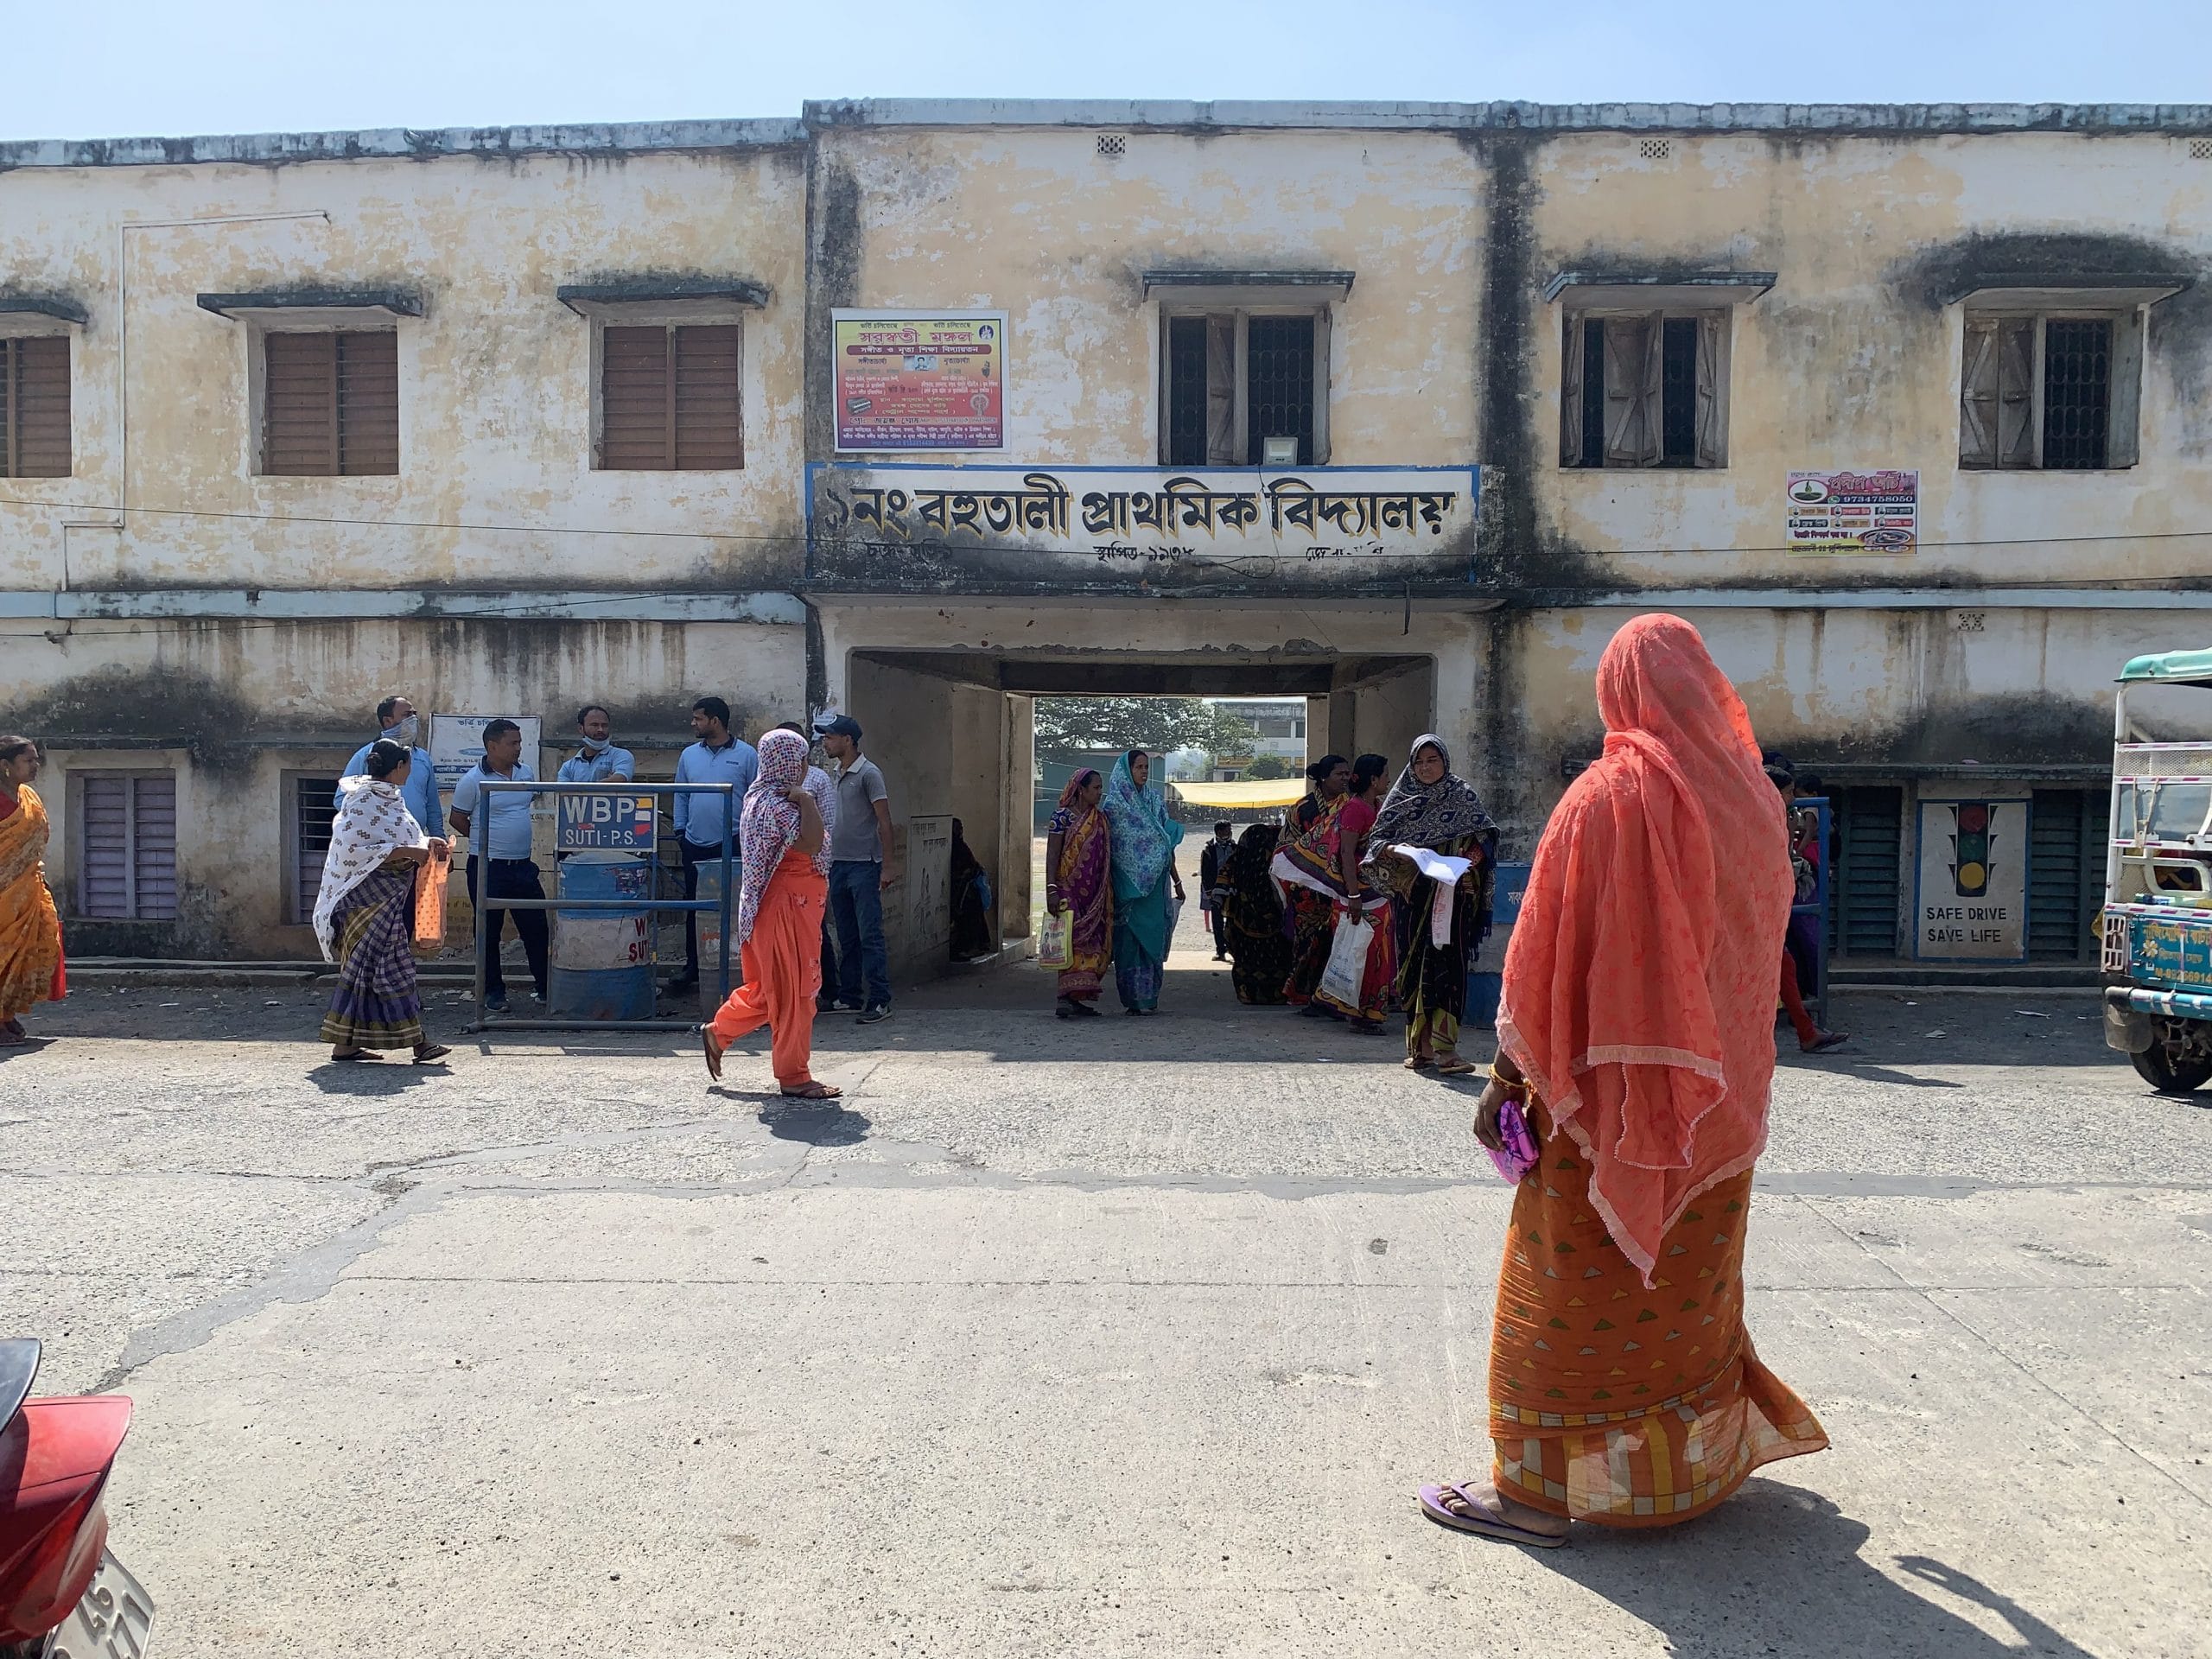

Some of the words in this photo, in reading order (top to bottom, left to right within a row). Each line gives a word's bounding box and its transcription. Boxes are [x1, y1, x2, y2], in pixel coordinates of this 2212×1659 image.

[858, 327, 919, 344] সরস্বতী
[914, 473, 1074, 539] বহুতালী
[1082, 476, 1262, 539] প্রাথমিক
[1263, 476, 1459, 539] বিদ্যালয়
[563, 796, 635, 823] WBP
[1926, 907, 1963, 920] SAFE
[1968, 907, 2007, 920] DRIVE
[1928, 929, 1963, 942] SAVE
[1971, 929, 2001, 942] LIFE
